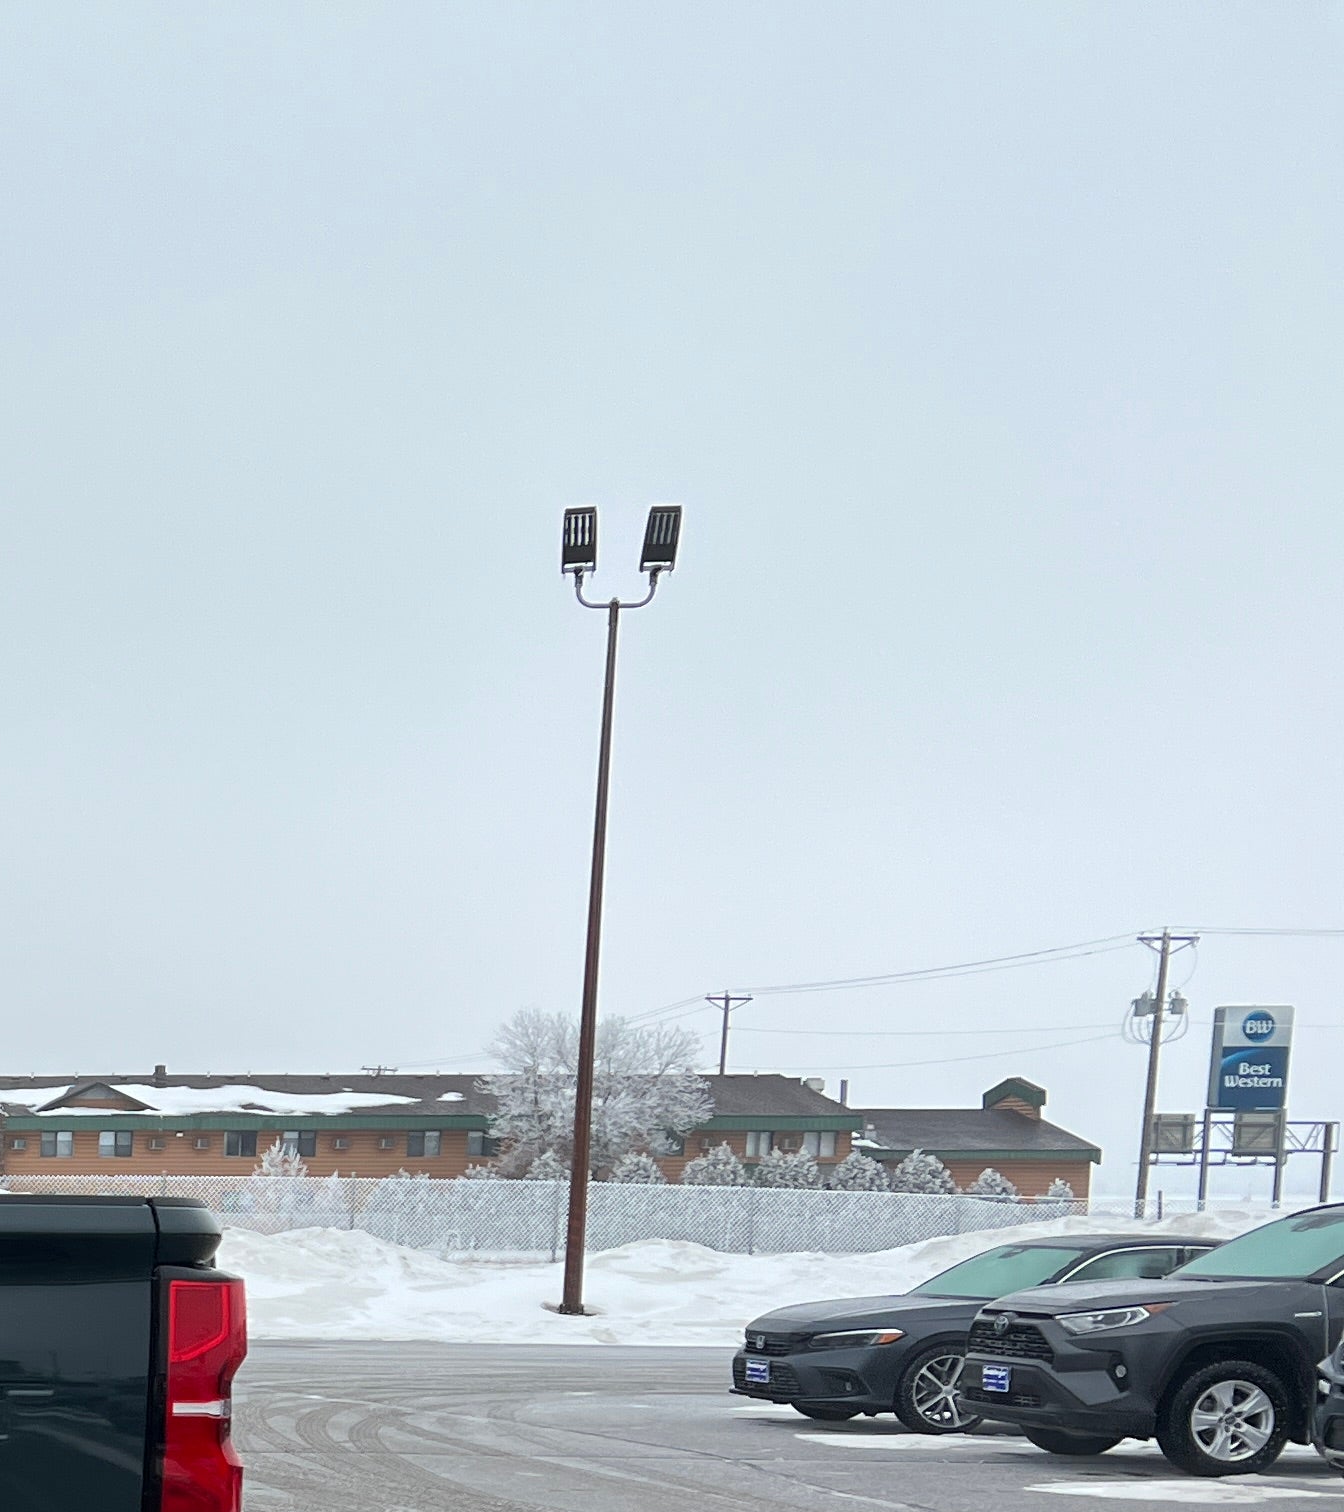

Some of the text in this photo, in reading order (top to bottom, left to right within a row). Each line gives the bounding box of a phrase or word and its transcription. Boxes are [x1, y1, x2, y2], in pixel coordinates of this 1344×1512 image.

[1245, 1020, 1273, 1034] BW
[1239, 1062, 1272, 1075] Best
[1224, 1075, 1283, 1088] Western
